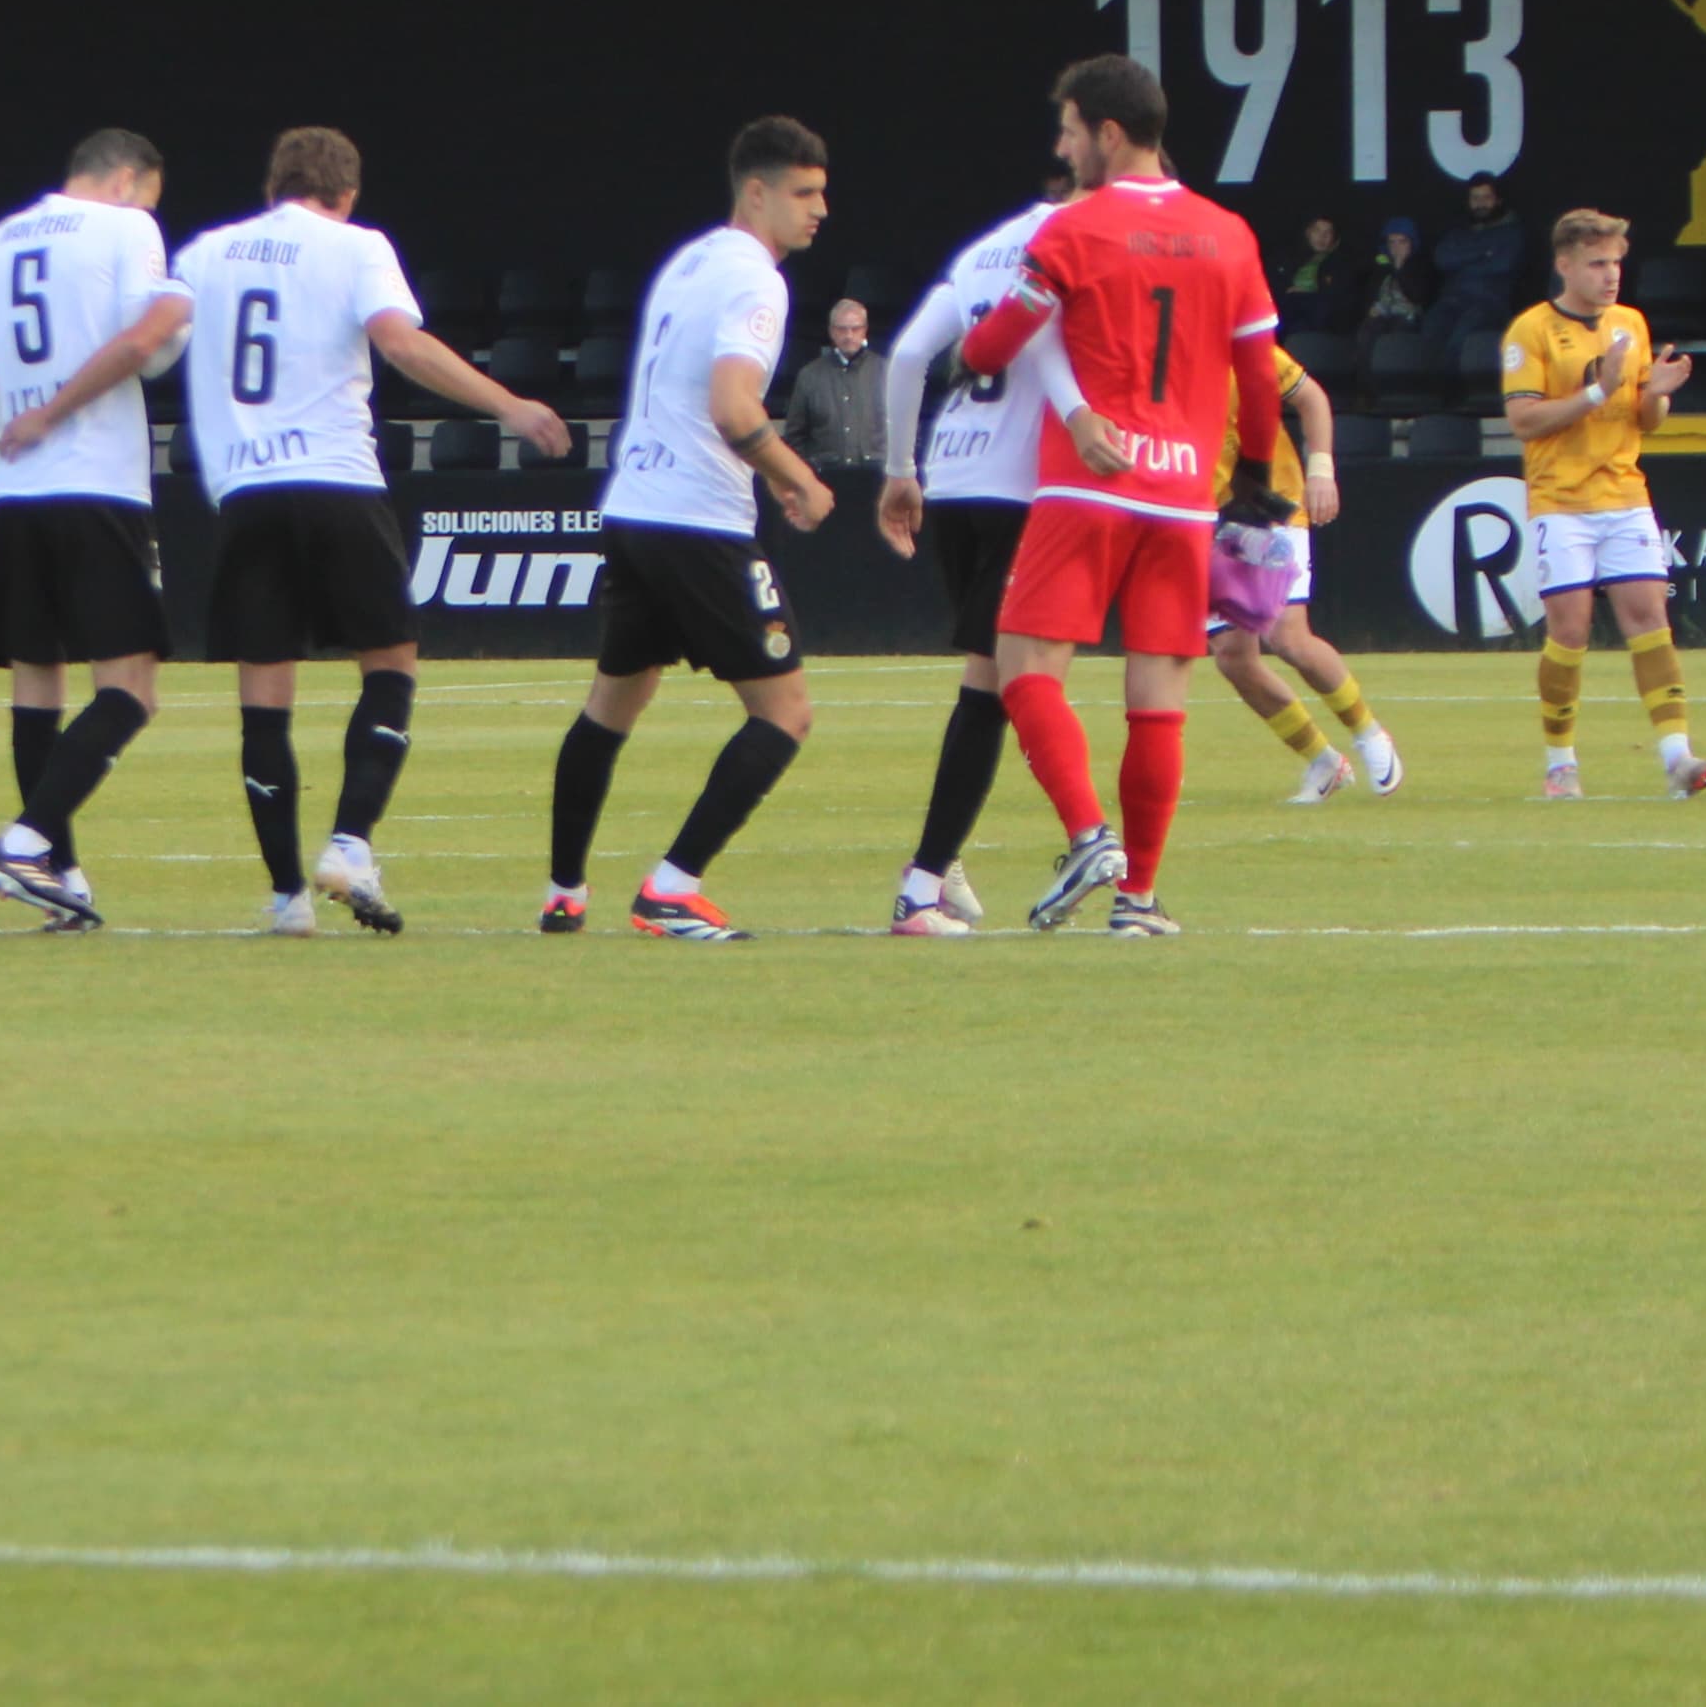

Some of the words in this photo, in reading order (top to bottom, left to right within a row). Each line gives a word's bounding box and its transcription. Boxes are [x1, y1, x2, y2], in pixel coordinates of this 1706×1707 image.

[11, 248, 53, 364] 5
[232, 288, 280, 405] 6
[1149, 286, 1176, 404] 1
[422, 510, 556, 534] SOLUCIONES
[561, 509, 604, 533] ELE
[749, 558, 781, 611] 2
